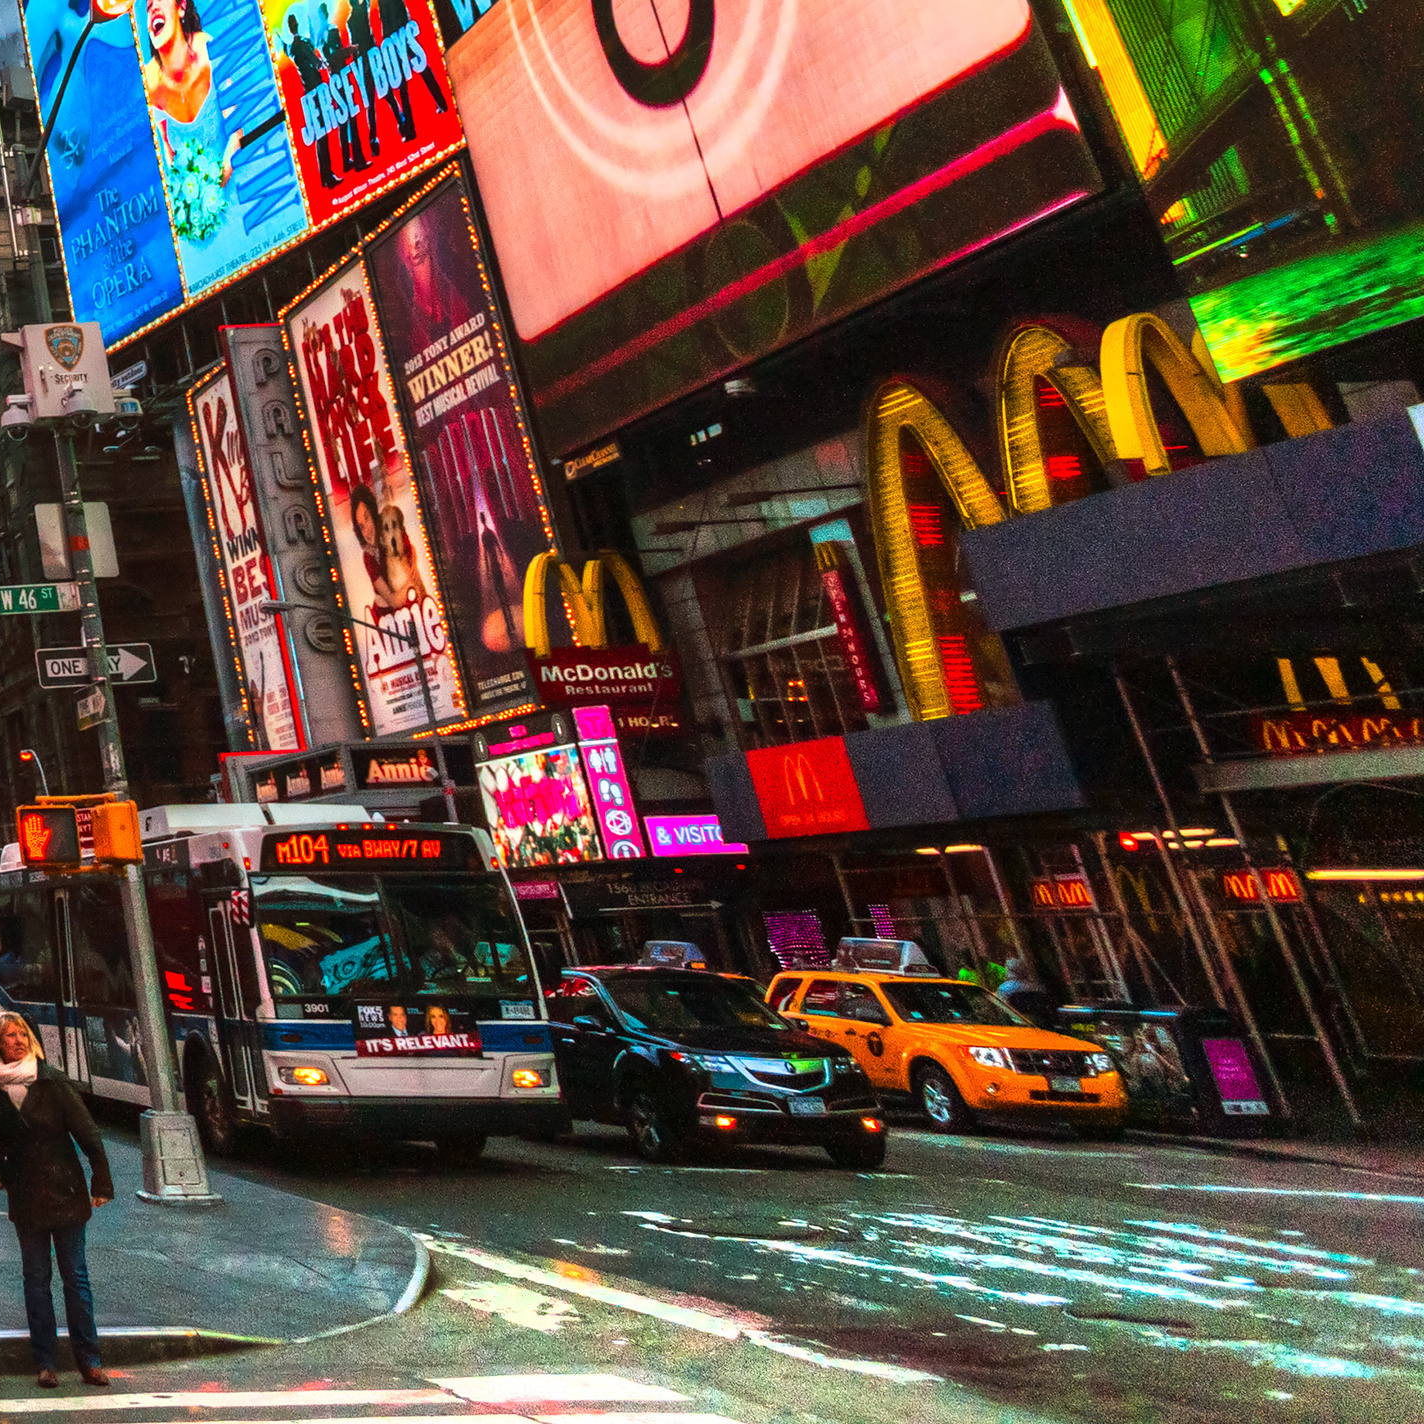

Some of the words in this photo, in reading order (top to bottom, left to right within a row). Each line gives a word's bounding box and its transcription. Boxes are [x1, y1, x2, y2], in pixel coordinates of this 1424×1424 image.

[301, 56, 367, 146] JERSEY
[367, 20, 427, 88] BOYS
[95, 185, 118, 212] The
[71, 185, 159, 265] PHANTOM
[116, 238, 133, 260] the
[91, 256, 152, 310] OPERA
[423, 340, 448, 363] TONY
[449, 314, 485, 347] AWARD
[407, 331, 494, 402] WINNER!
[416, 397, 434, 427] BEST
[434, 380, 465, 417] MUSICAL
[464, 363, 500, 401] REVIVAL
[253, 345, 340, 652] PALACE
[1, 591, 13, 610] W
[19, 589, 37, 610] 46
[41, 587, 52, 599] ST
[365, 588, 446, 676] Annie
[50, 659, 82, 675] ONE
[541, 662, 673, 683] McDonald's
[565, 682, 653, 696] Restaurant
[368, 756, 431, 783] Annie
[657, 826, 671, 844] &
[277, 835, 329, 864] M104
[338, 844, 360, 858] VIA
[362, 841, 418, 860] BWAY/7
[422, 840, 441, 858] AV
[304, 1003, 330, 1014] 3901
[365, 1037, 393, 1053] IT'S
[395, 1033, 474, 1052] RELEVANT.
